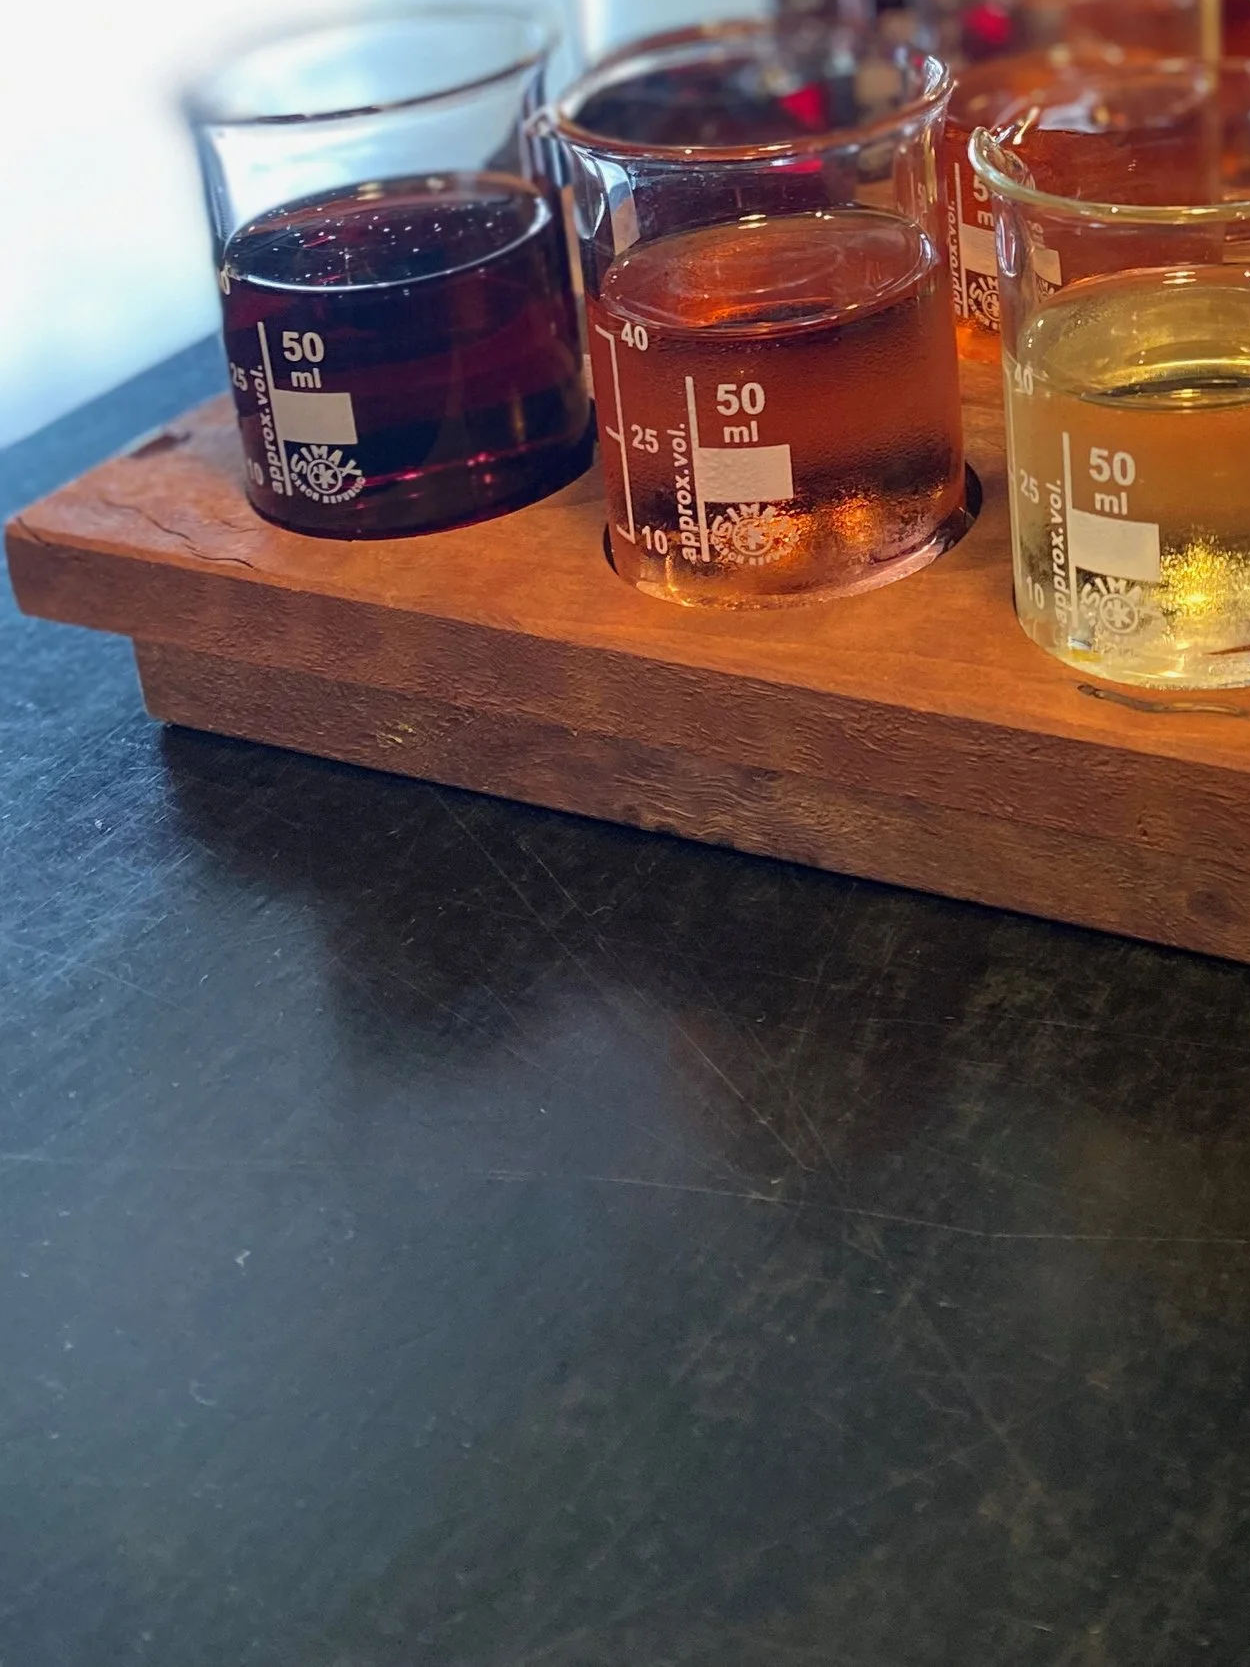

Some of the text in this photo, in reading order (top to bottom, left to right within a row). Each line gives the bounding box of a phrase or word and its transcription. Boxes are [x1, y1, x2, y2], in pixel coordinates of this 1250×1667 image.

[281, 331, 325, 363] 50
[620, 321, 649, 351] 40
[230, 362, 248, 392] 25
[290, 368, 322, 389] ml
[716, 382, 766, 417] 50
[250, 365, 284, 495] approx.vol.
[631, 424, 660, 454] 25
[723, 420, 759, 444] ml
[290, 444, 363, 477] SIMAX
[1089, 446, 1136, 487] 50
[667, 423, 699, 564] approx.vol.
[1020, 469, 1040, 505] 25
[1094, 491, 1129, 516] ml
[641, 525, 668, 555] 10
[1026, 576, 1046, 611] 10
